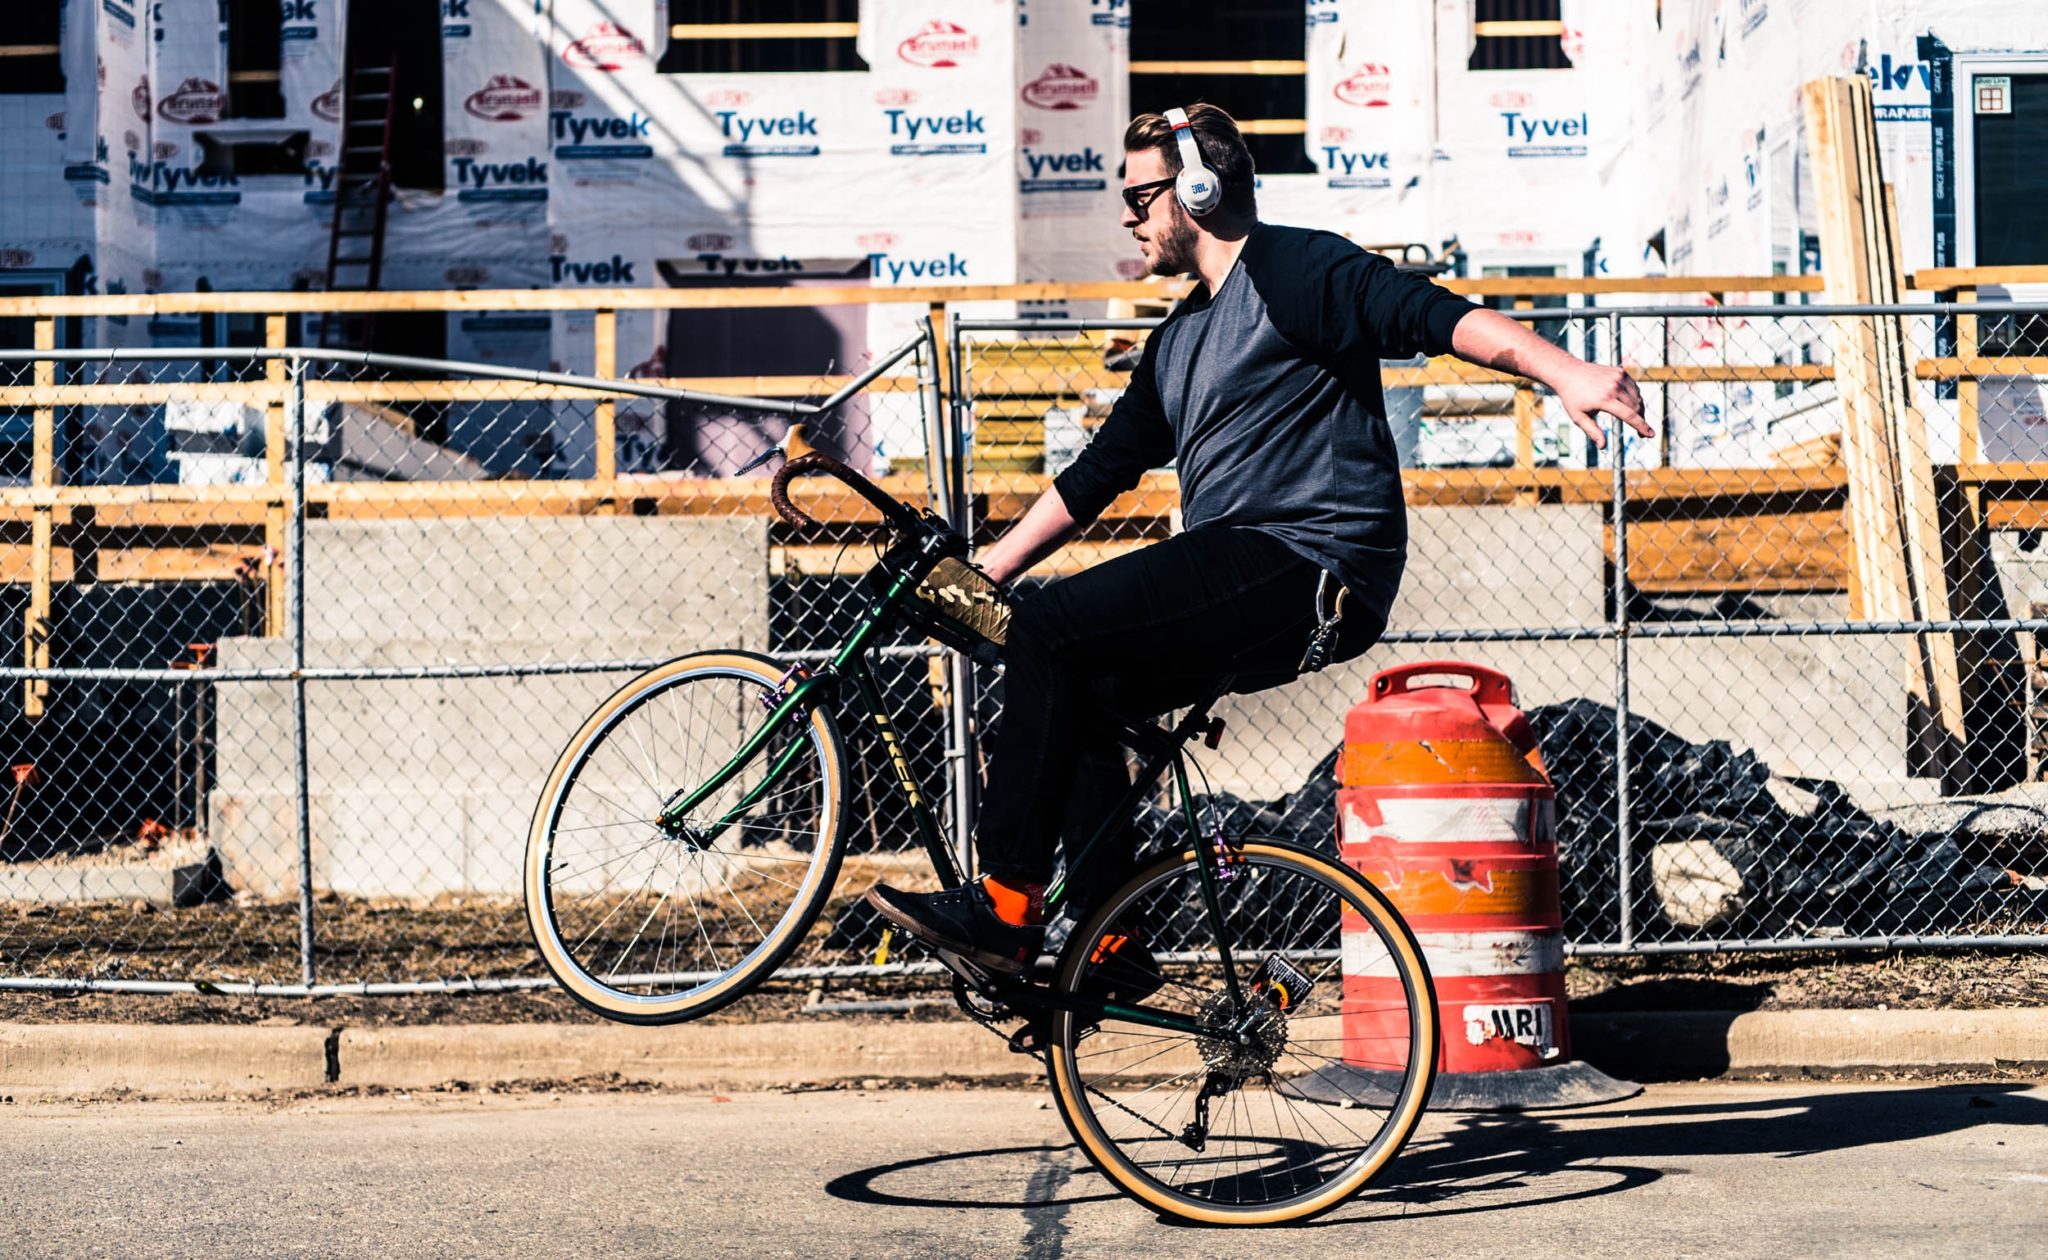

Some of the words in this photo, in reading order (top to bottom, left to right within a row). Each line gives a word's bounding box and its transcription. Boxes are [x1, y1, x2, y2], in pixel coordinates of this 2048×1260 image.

[551, 112, 650, 144] Tyvek
[716, 111, 818, 142] Tyvek
[884, 110, 985, 140] Tyvek
[451, 156, 548, 188] Tyvek
[1026, 148, 1104, 178] yvek
[1191, 182, 1209, 195] JBL
[868, 252, 968, 284] Tyvek
